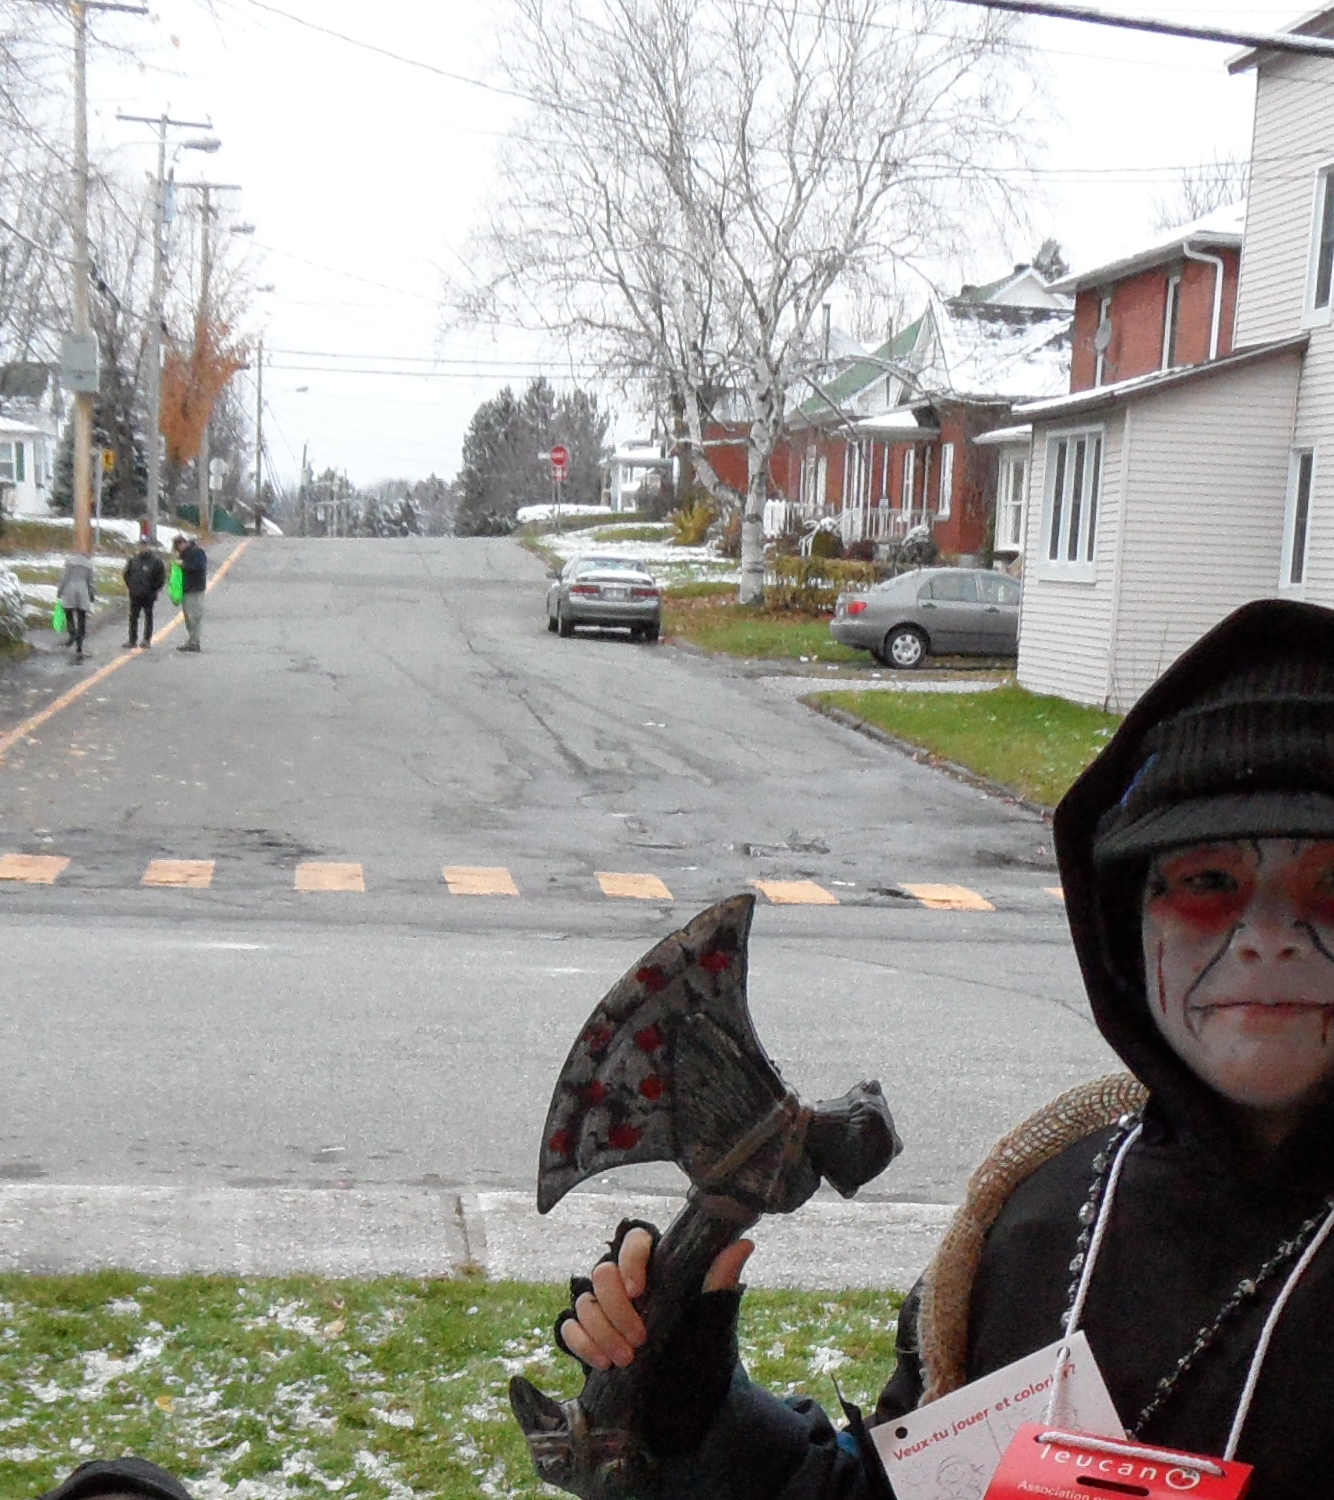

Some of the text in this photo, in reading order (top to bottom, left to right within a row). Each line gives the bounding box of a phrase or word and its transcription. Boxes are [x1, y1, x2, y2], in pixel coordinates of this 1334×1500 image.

[893, 1428, 950, 1461] Veux-tu
[952, 1408, 990, 1436] jouer
[995, 1397, 1011, 1411] et
[1040, 1444, 1157, 1481] leucan
